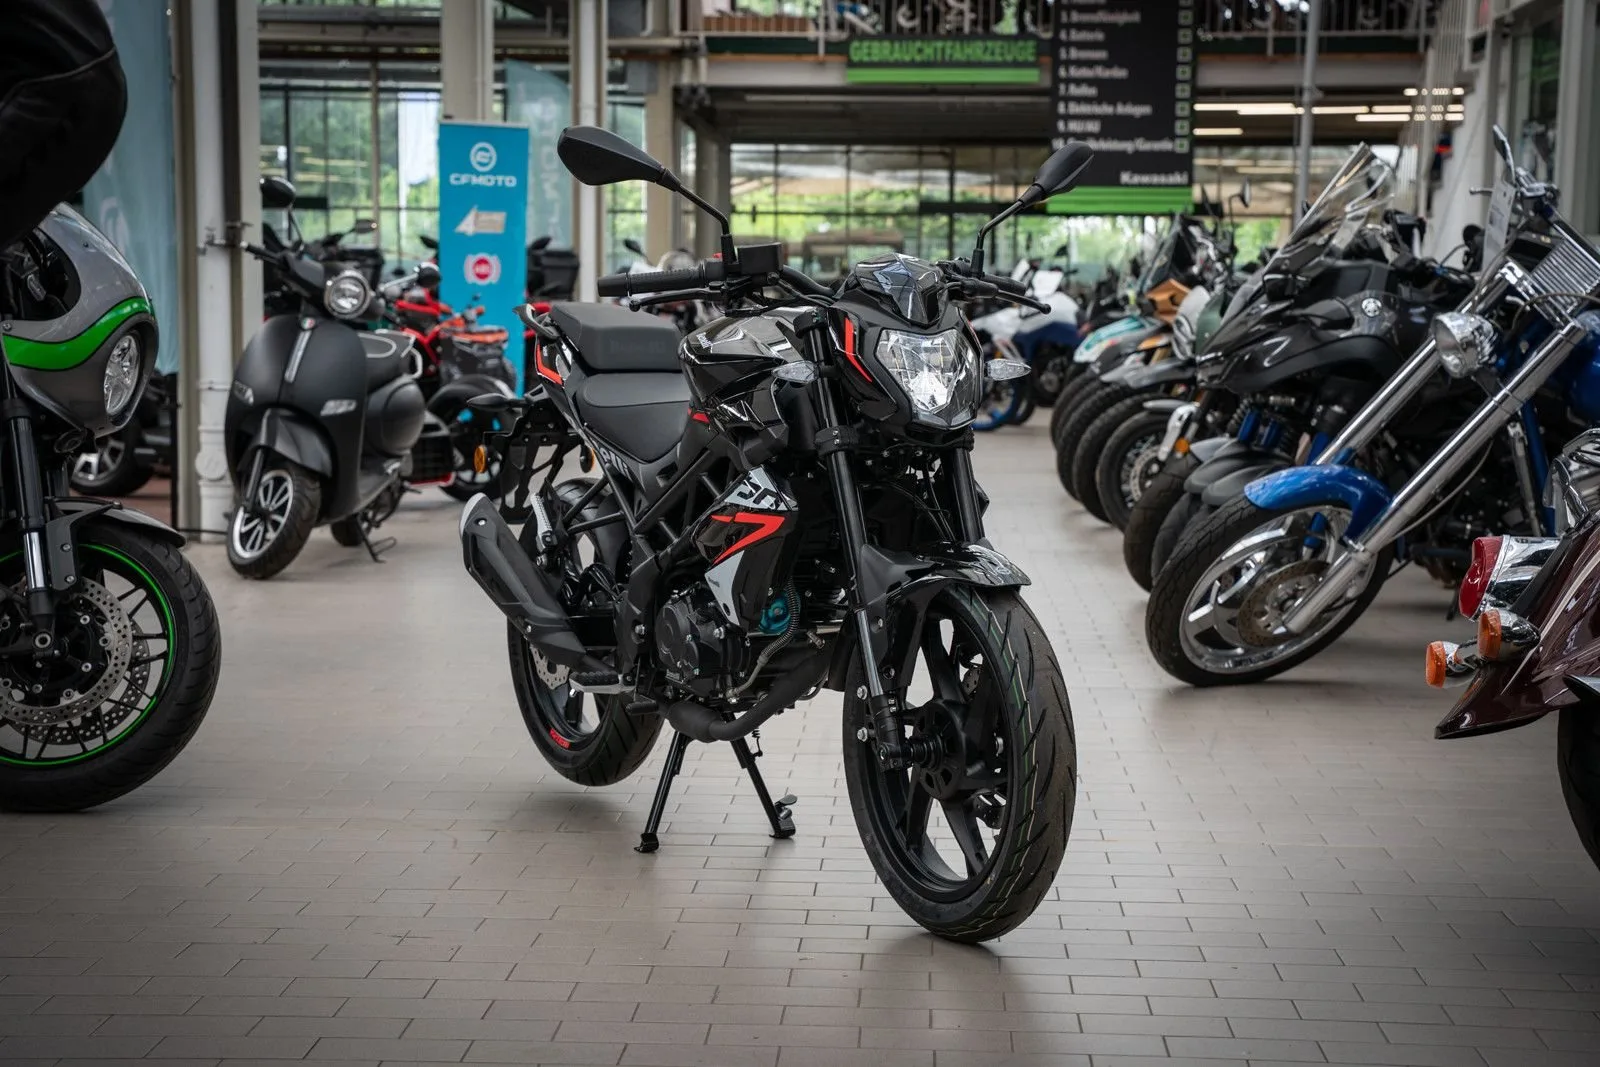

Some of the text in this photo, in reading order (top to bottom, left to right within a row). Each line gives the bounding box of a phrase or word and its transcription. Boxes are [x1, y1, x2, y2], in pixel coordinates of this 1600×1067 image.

[850, 40, 1038, 62] GEBRAUCHTFAHRZEUGE
[449, 173, 517, 188] CFMOTO
[1120, 171, 1188, 185] Kawasaki
